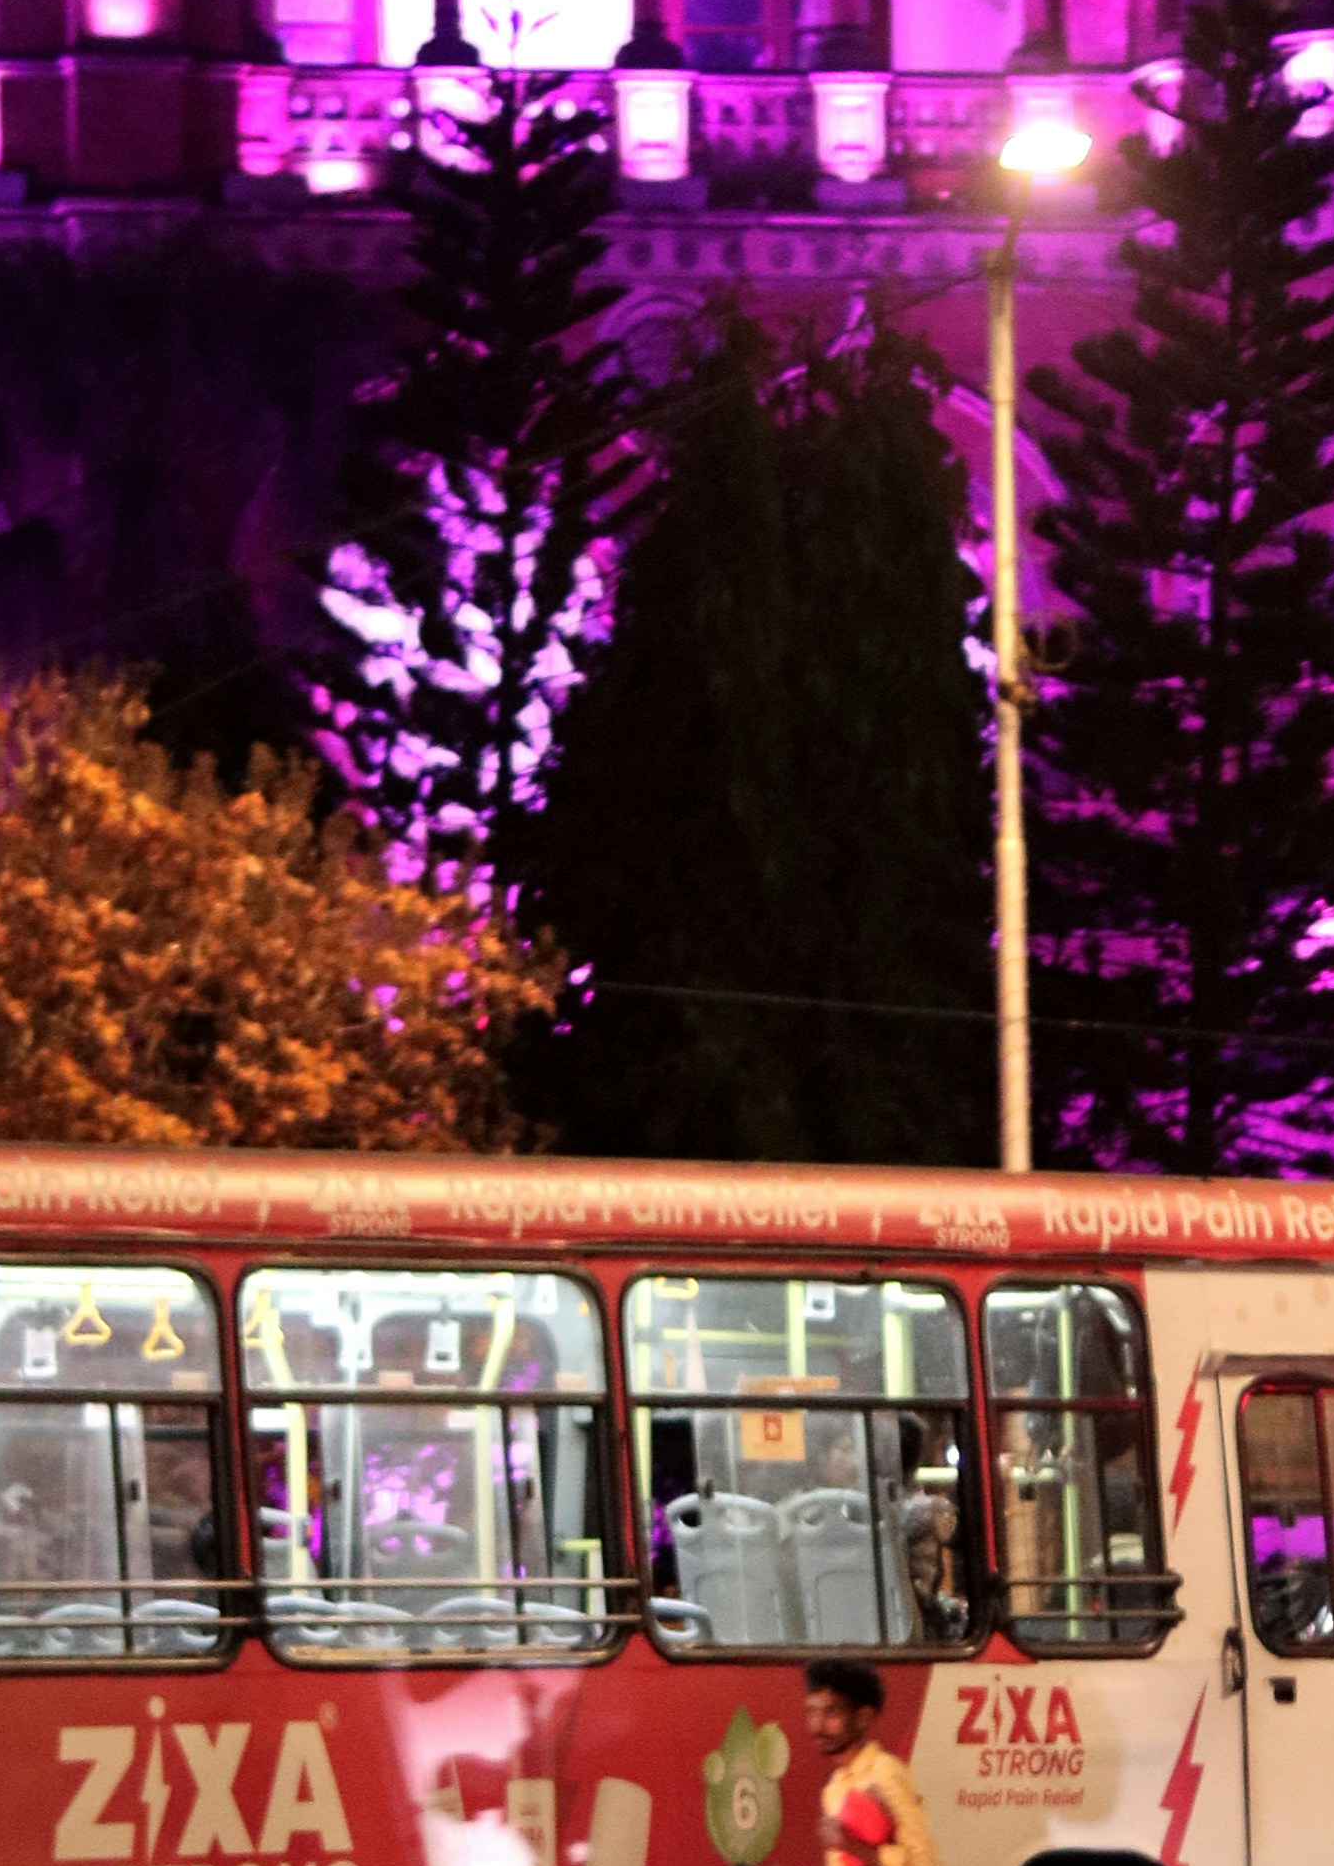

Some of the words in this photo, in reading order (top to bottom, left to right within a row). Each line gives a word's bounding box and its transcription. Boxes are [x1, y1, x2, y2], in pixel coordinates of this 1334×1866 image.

[85, 1160, 220, 1215] Relief
[447, 1169, 586, 1242] Rapid
[598, 1176, 703, 1227] Pain
[713, 1176, 838, 1229] Relief
[1038, 1186, 1168, 1252] Rapid
[1176, 1188, 1274, 1240] Pain
[978, 1748, 1085, 1777] STRONG
[732, 1776, 758, 1831] 6
[957, 1788, 1002, 1811] Rapid
[1006, 1788, 1039, 1806] Pain
[1043, 1788, 1085, 1807] Relief
